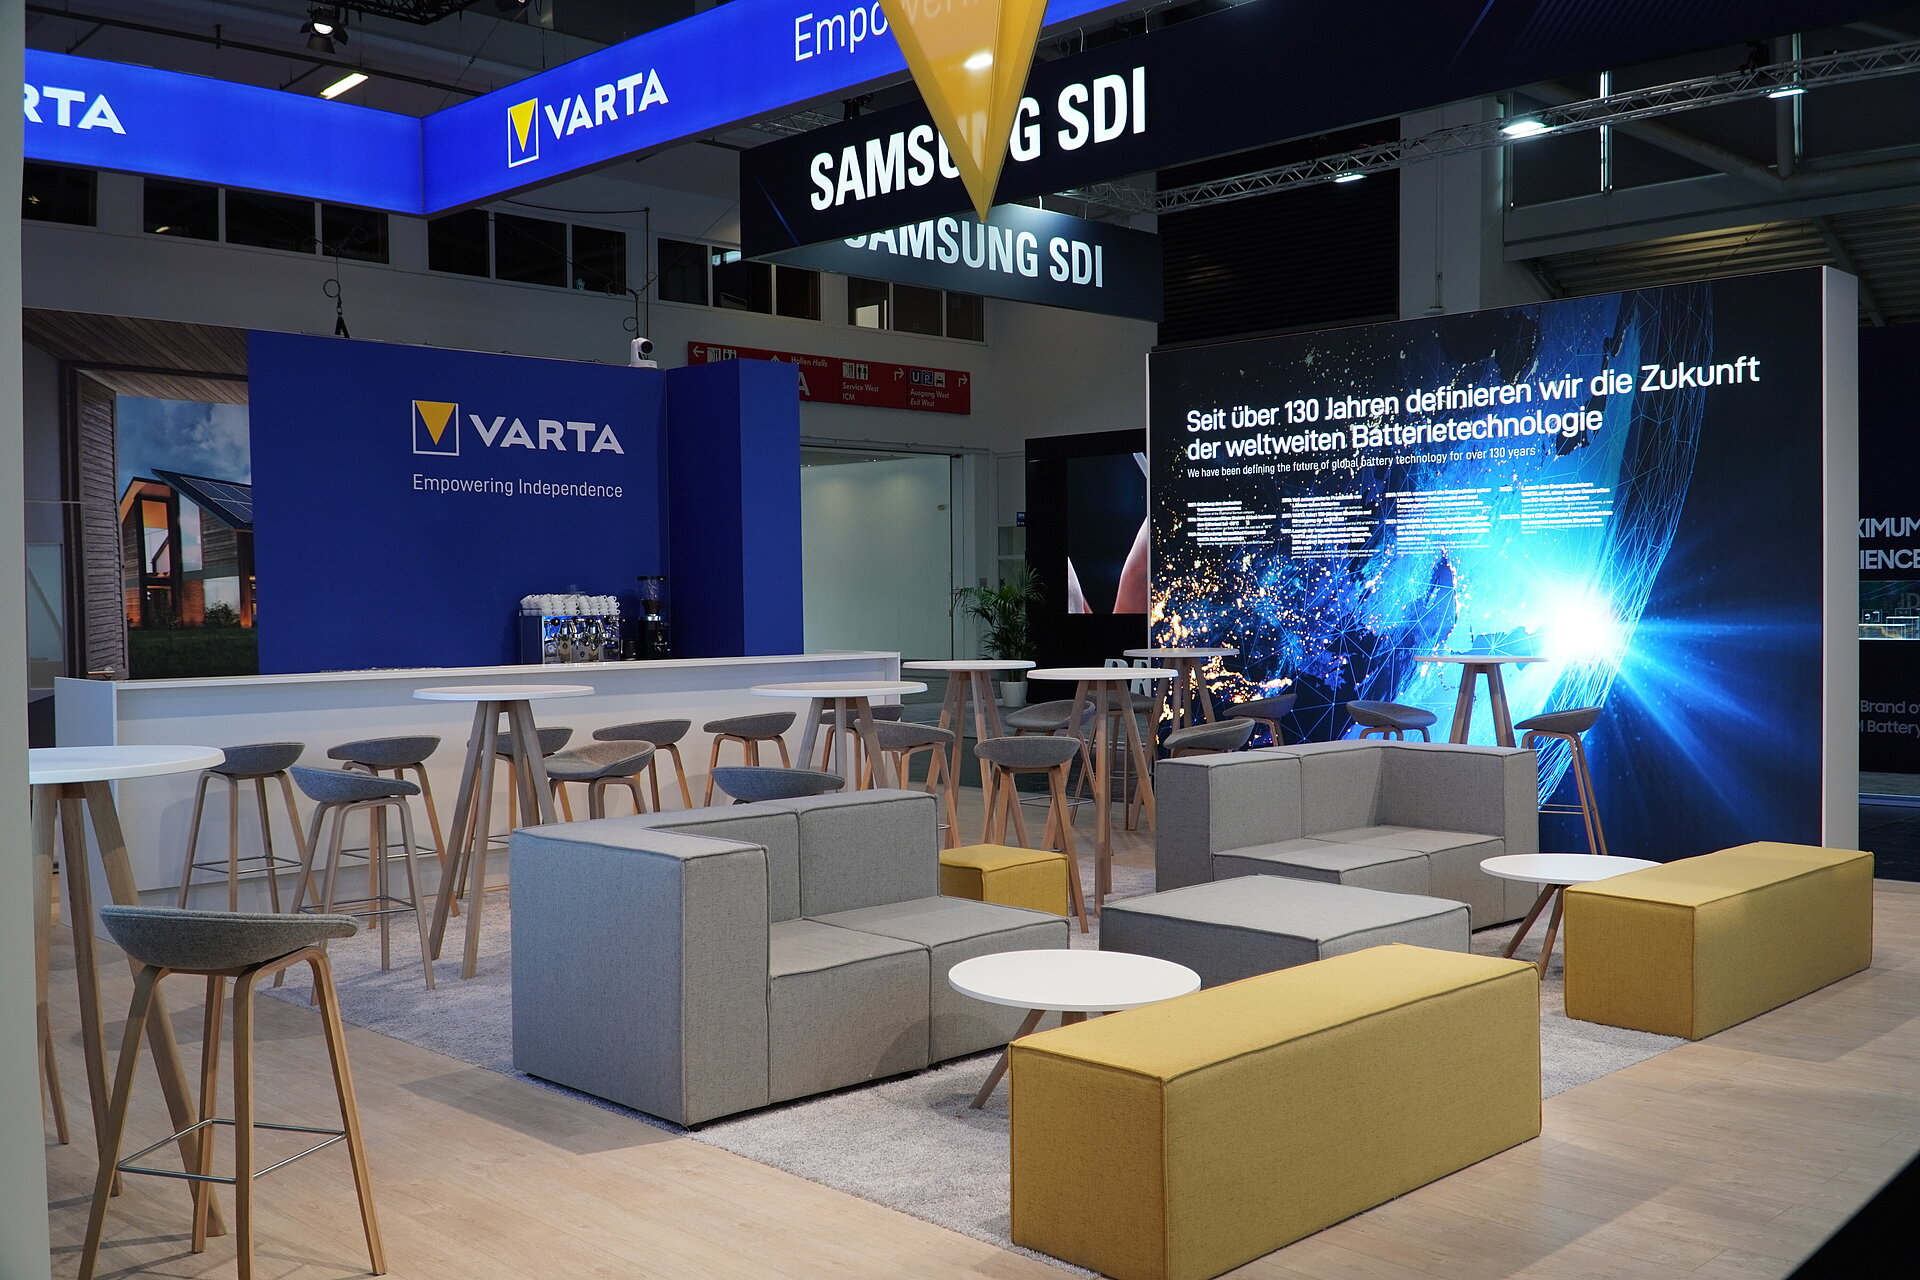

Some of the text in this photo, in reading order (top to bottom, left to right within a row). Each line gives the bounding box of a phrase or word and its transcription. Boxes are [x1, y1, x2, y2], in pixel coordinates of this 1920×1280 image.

[544, 68, 669, 140] VARTA
[810, 66, 1146, 211] SAMSUG SDI
[1049, 237, 1103, 288] SDI
[812, 358, 828, 368] Halls
[842, 382, 879, 393] Service West
[842, 392, 856, 401] ICM
[910, 388, 950, 400] Ausgang West
[1186, 356, 1761, 433] Seit über 130 Jahren definieren wir die Zukunft
[910, 398, 935, 407] Exit West
[469, 414, 625, 455] VARTA
[1187, 406, 1603, 461] der weltweiten Batterietechnologie
[1187, 447, 1536, 479] We have been defining the future of global battery technology for over 130 years
[413, 474, 623, 498] Empowering Independence
[1860, 699, 1906, 714] Brand
